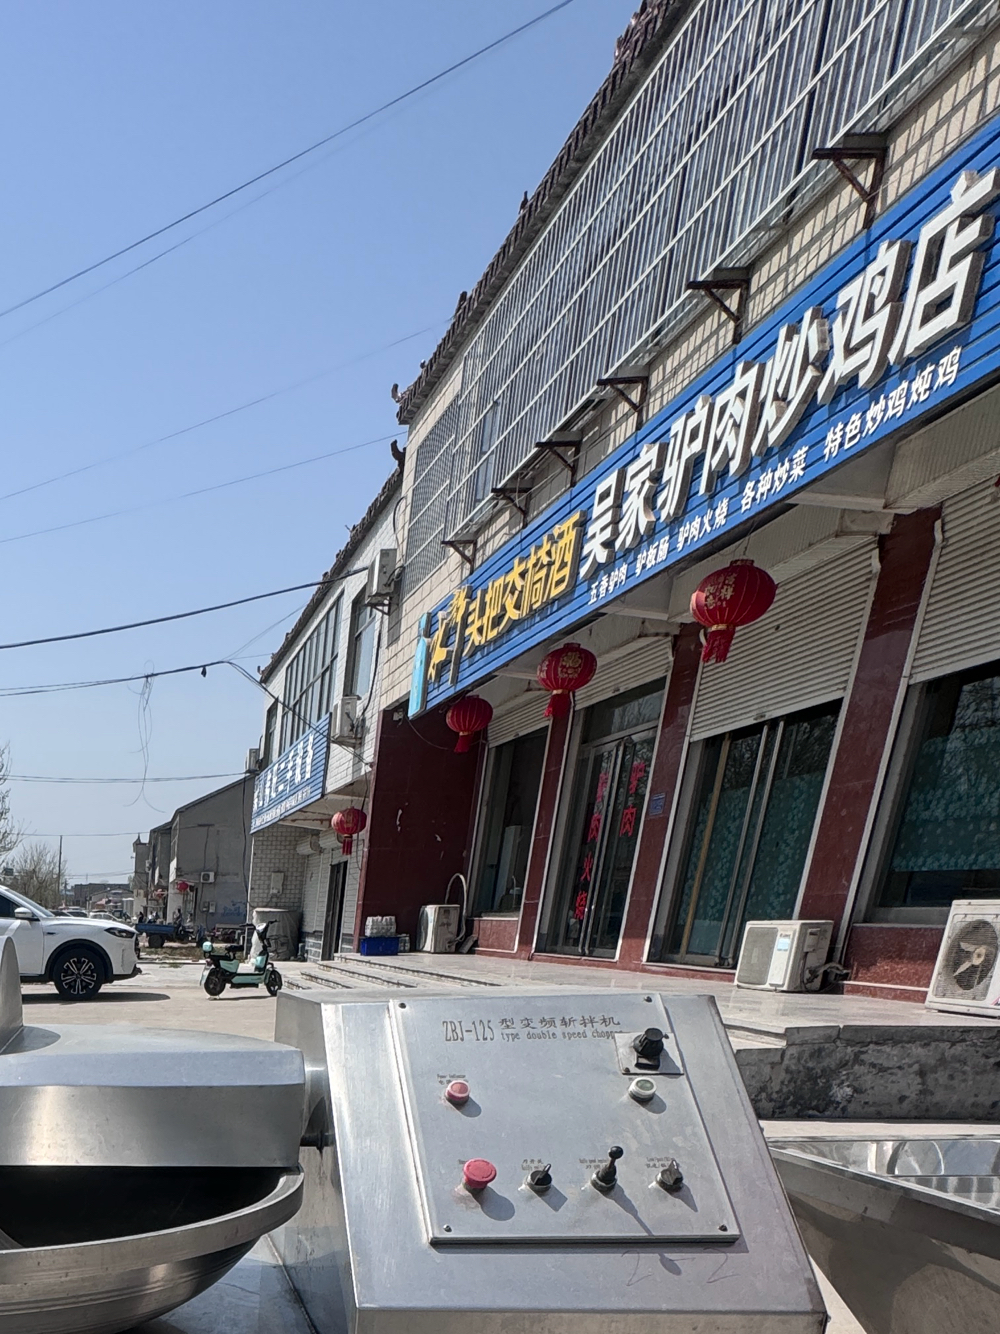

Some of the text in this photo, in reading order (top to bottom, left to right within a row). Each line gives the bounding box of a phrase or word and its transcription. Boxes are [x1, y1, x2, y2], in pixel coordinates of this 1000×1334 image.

[579, 168, 999, 579] 吴家驴肉炒鸡店
[588, 562, 628, 605] 五香驴肉
[676, 496, 730, 552] 驴肉火烧
[740, 444, 809, 513] 各种炒菜
[823, 345, 962, 463] 特色炒鸡炖鸡
[463, 511, 581, 657] 头把交椅酒
[441, 1014, 621, 1043] ZBJ-125 型变频斩拌机
[501, 1031, 521, 1043] type
[526, 1029, 556, 1040] double
[562, 1029, 587, 1041] speed
